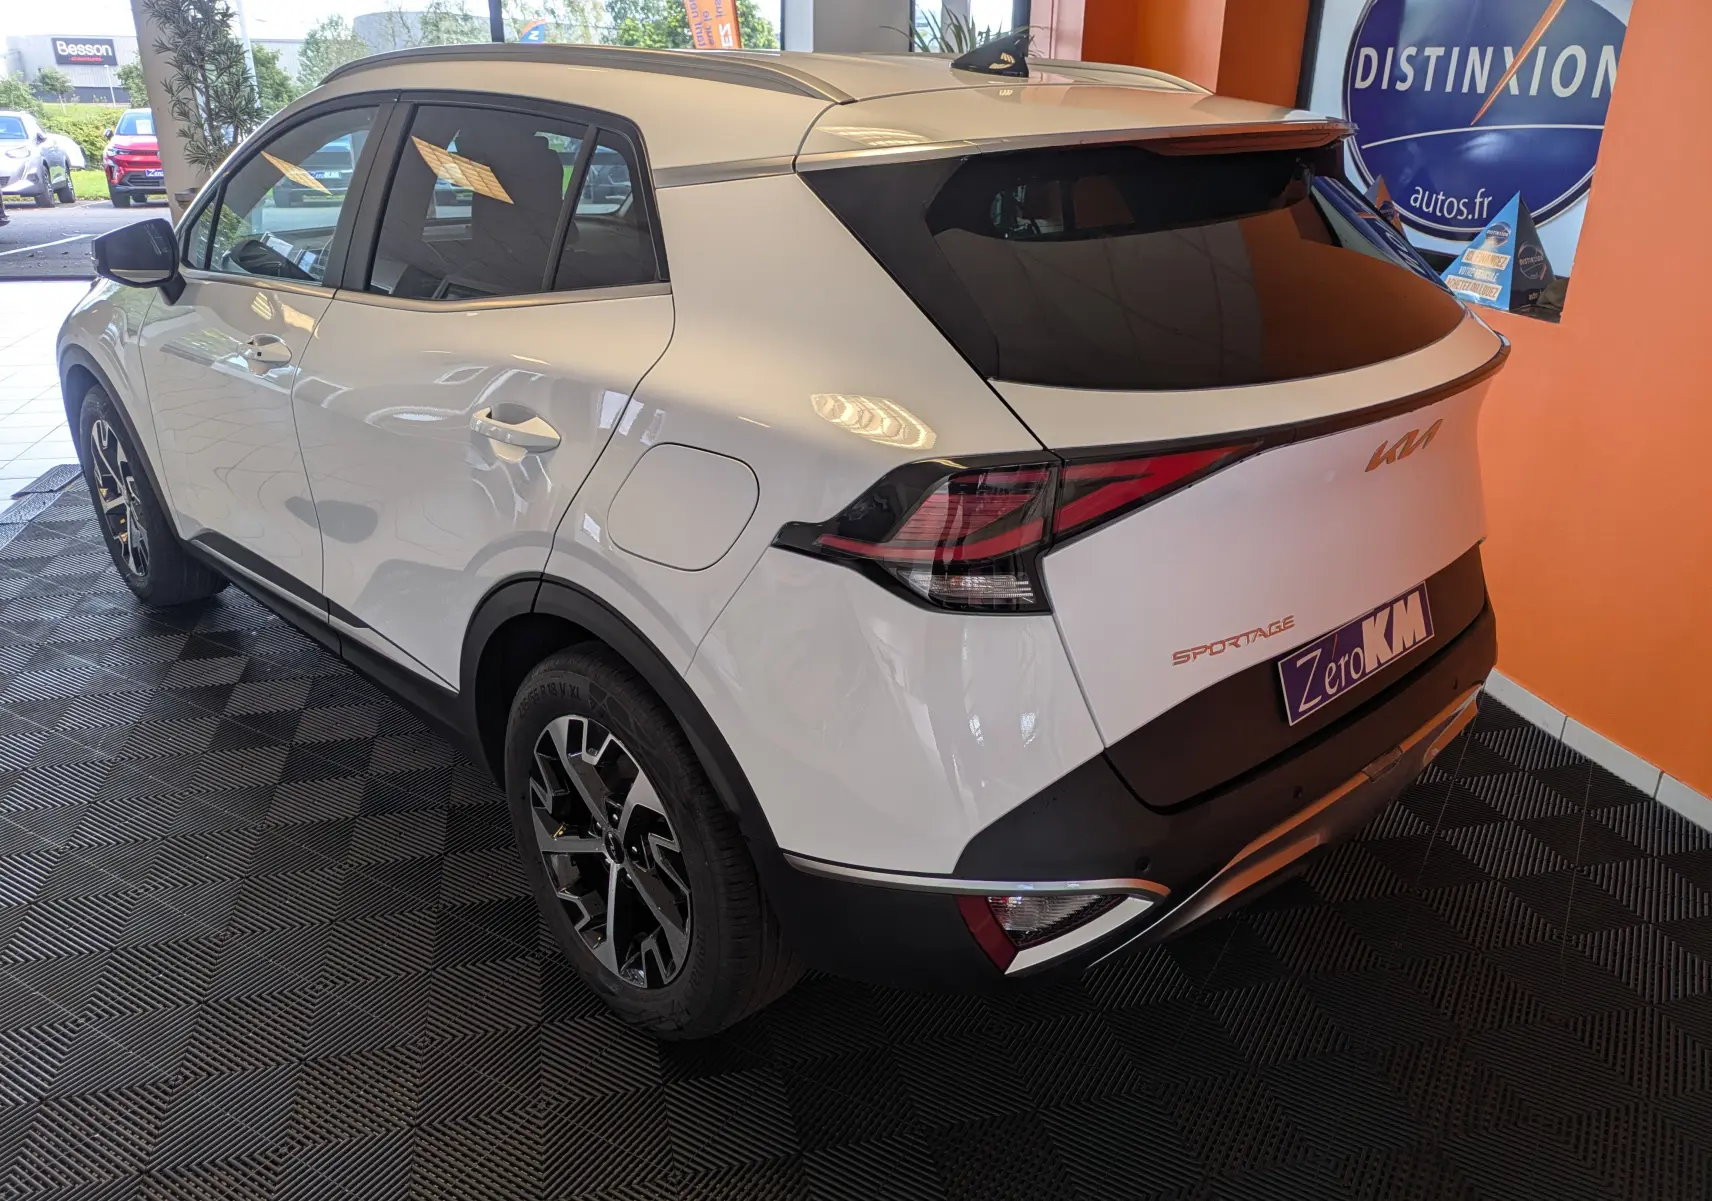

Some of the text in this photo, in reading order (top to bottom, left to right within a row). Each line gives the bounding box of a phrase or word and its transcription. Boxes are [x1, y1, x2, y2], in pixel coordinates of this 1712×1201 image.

[56, 40, 113, 56] Besson
[1354, 44, 1618, 98] DISTINXION
[1410, 186, 1493, 220] autos.fr
[1365, 418, 1444, 473] KIA
[1172, 615, 1296, 666] SPORTAGE
